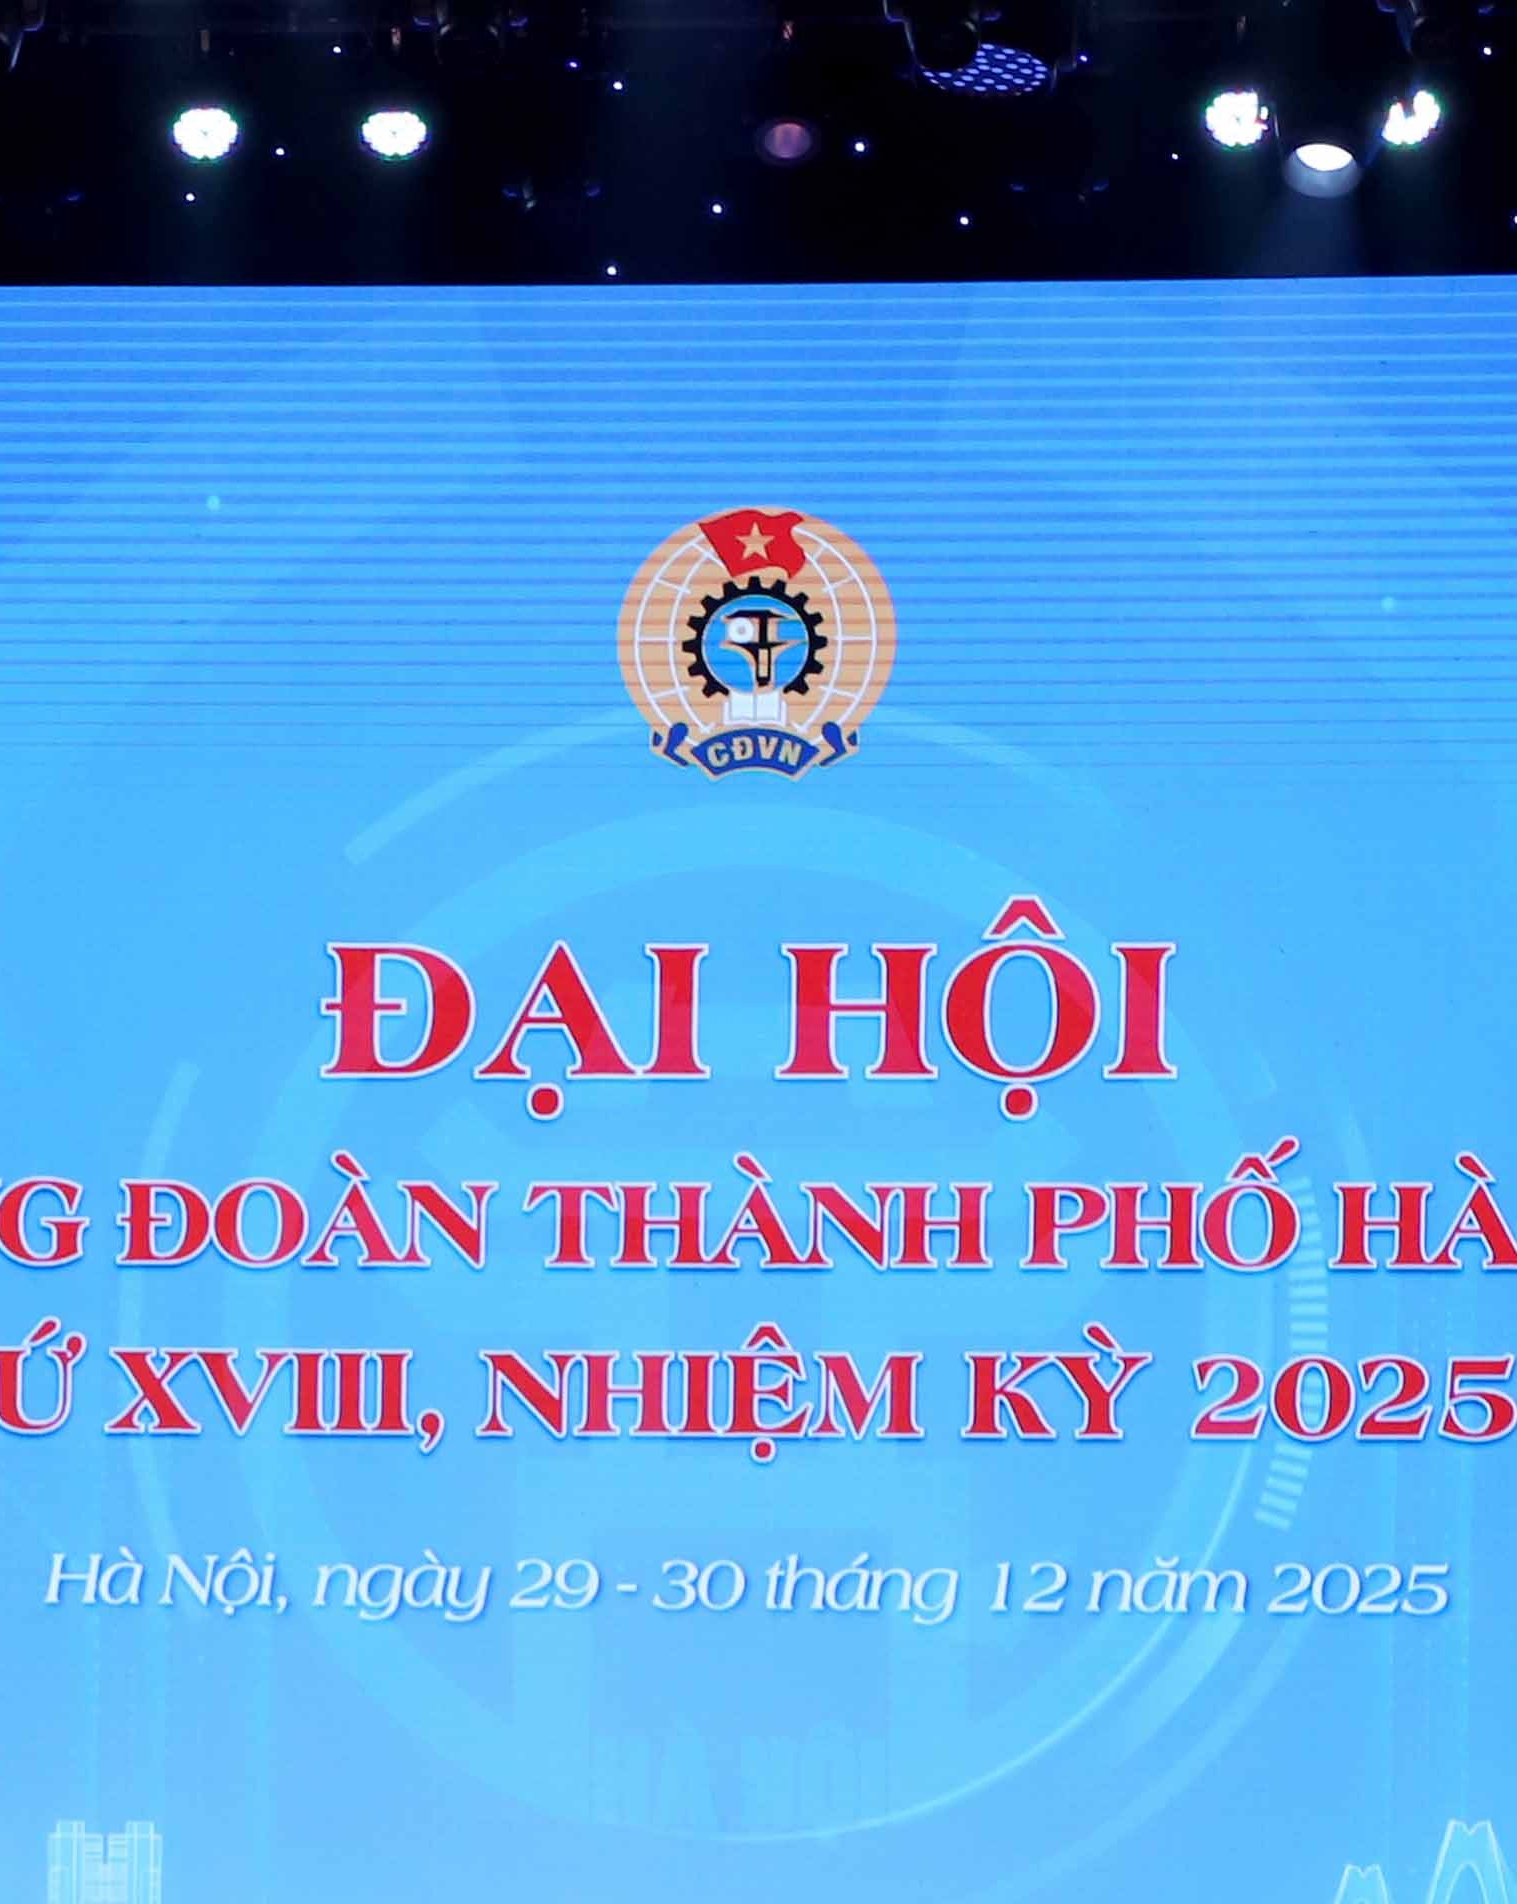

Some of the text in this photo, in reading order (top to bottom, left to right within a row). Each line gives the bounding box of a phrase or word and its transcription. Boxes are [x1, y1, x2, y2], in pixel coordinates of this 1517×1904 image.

[705, 734, 803, 769] CĐVN
[321, 895, 1178, 1120] ĐẠI HỘI
[116, 1150, 499, 1267] ĐOÀN
[523, 1152, 991, 1270] THÀNH
[1020, 1135, 1304, 1270] PHỐ
[105, 1346, 445, 1453] XVIII,
[475, 1321, 924, 1463] NHIỆM
[964, 1323, 1152, 1438] KỲ
[45, 1546, 1449, 1623] Hà Nội, ngày 29 - 30 tháng 12 năm 2025
